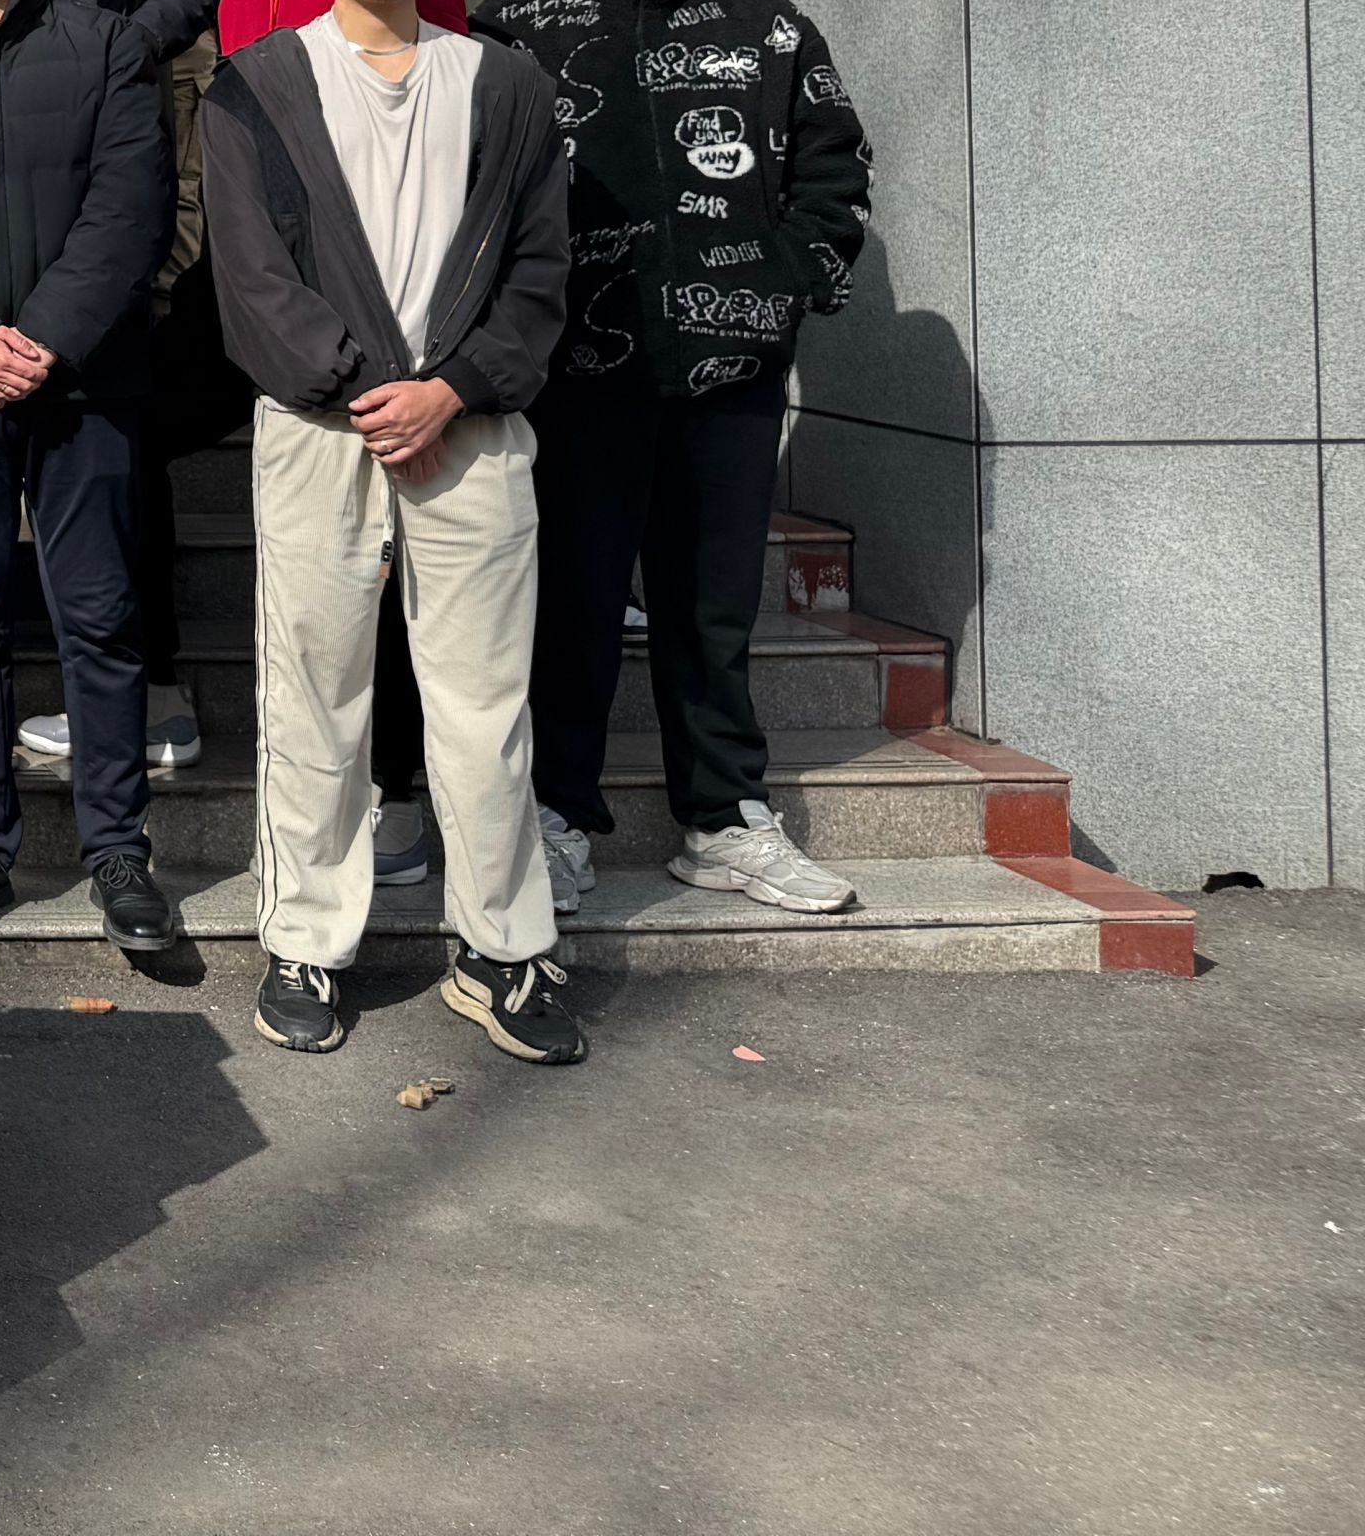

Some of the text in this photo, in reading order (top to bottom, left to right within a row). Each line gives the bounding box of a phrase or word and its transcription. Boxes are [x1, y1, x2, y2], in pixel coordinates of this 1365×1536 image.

[687, 109, 719, 131] Find
[695, 130, 736, 146] your
[698, 149, 742, 173] WAY
